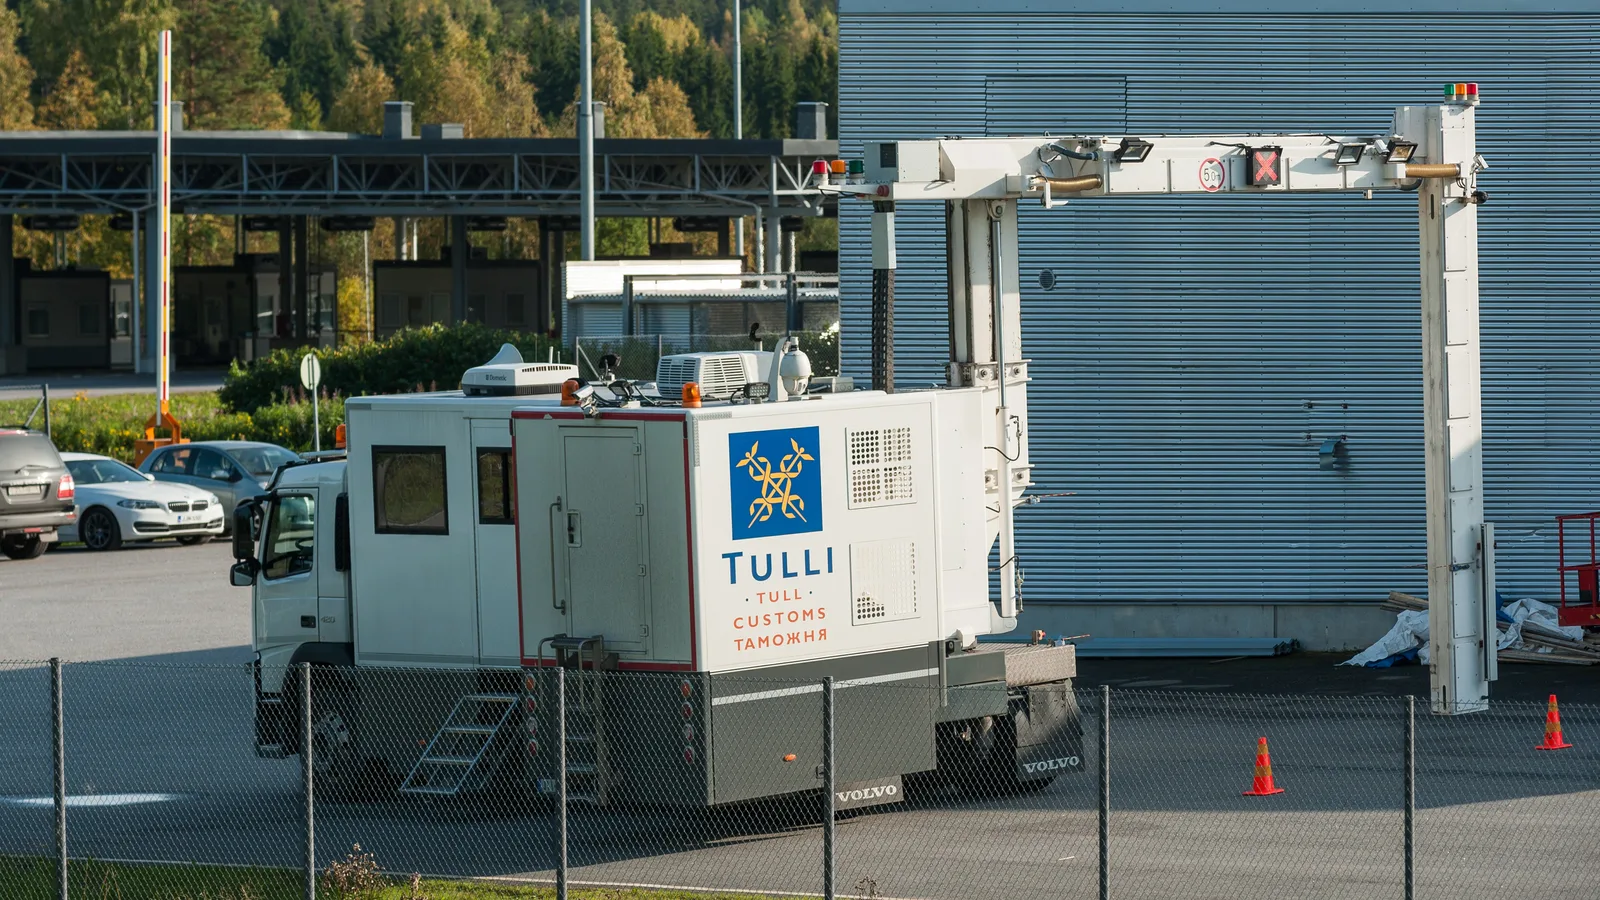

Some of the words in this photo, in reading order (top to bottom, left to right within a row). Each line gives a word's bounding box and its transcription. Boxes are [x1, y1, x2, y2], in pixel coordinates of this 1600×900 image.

[721, 547, 834, 585] TULLI
[756, 589, 803, 605] TULL
[733, 607, 826, 630] CUSTOMS
[733, 628, 828, 652] ТАМОЖНЯ
[1022, 756, 1080, 773] VOLVO
[835, 784, 897, 802] VOLVO
